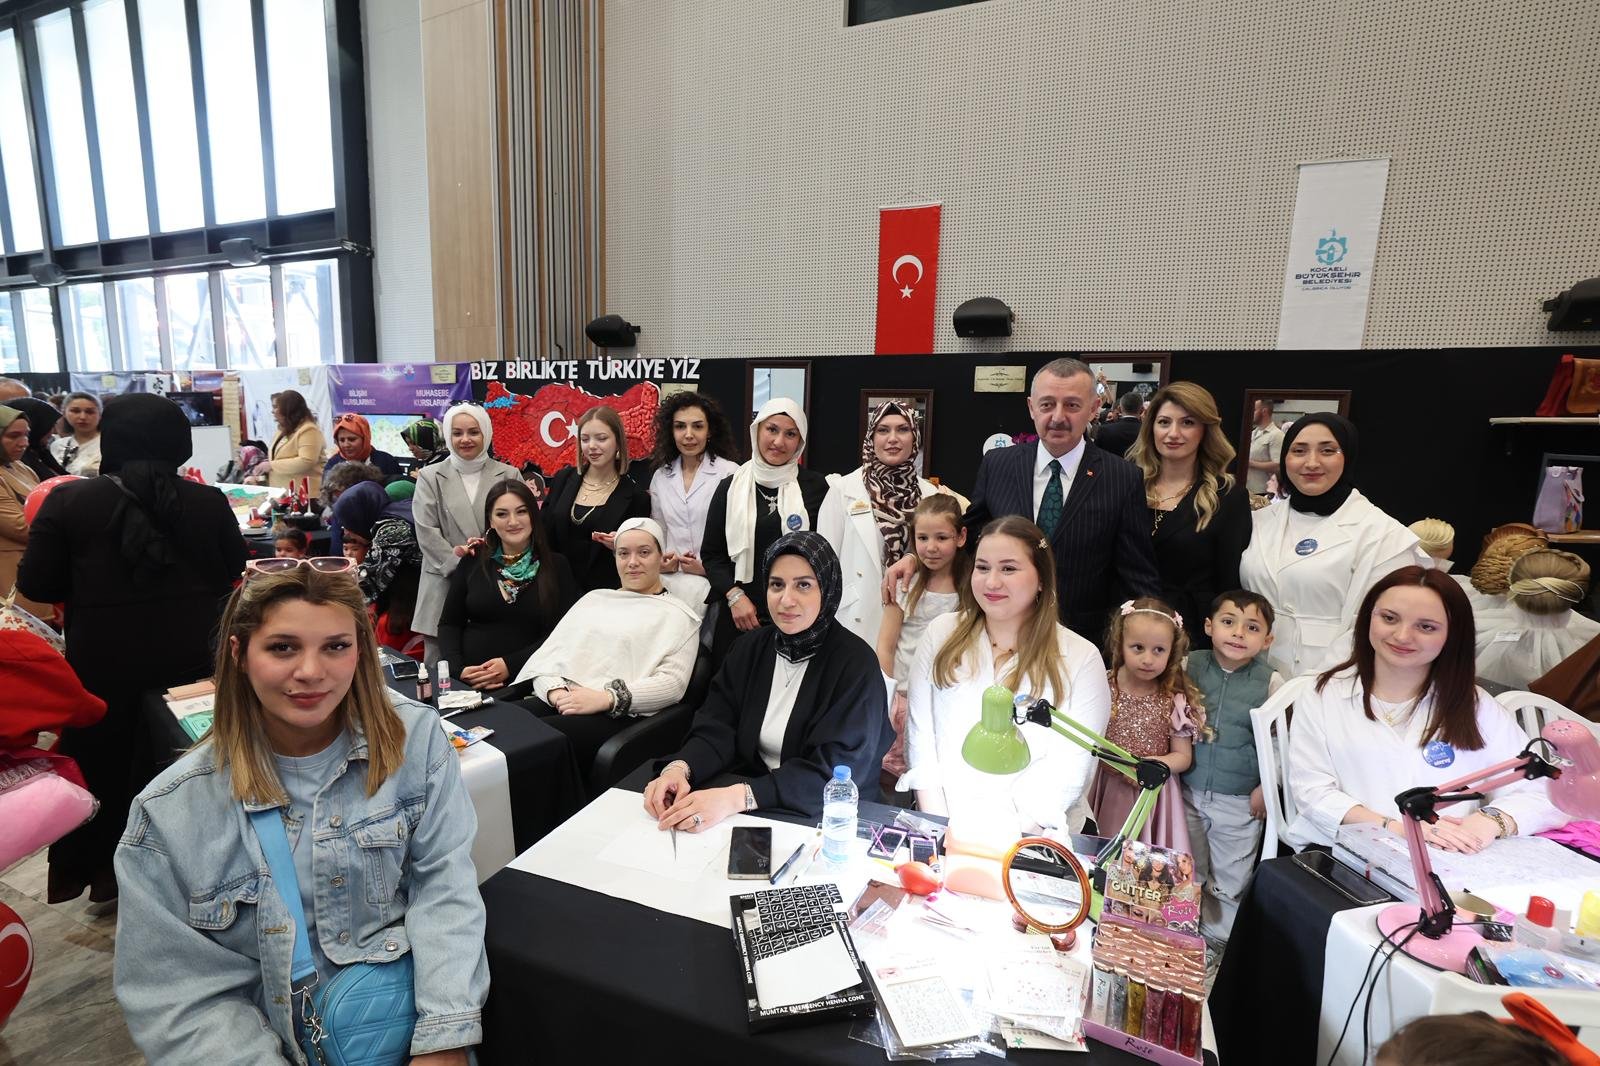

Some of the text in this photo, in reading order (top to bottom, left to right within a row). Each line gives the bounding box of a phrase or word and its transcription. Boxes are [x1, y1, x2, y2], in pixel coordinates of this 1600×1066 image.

[471, 357, 498, 380] BİZ
[505, 356, 579, 380] BİRLİKTE
[415, 389, 449, 397] MUHASEBE
[1111, 880, 1162, 902] GLITTER
[760, 994, 865, 1016] MUMTAZ EMERGENCY HENNA CONE
